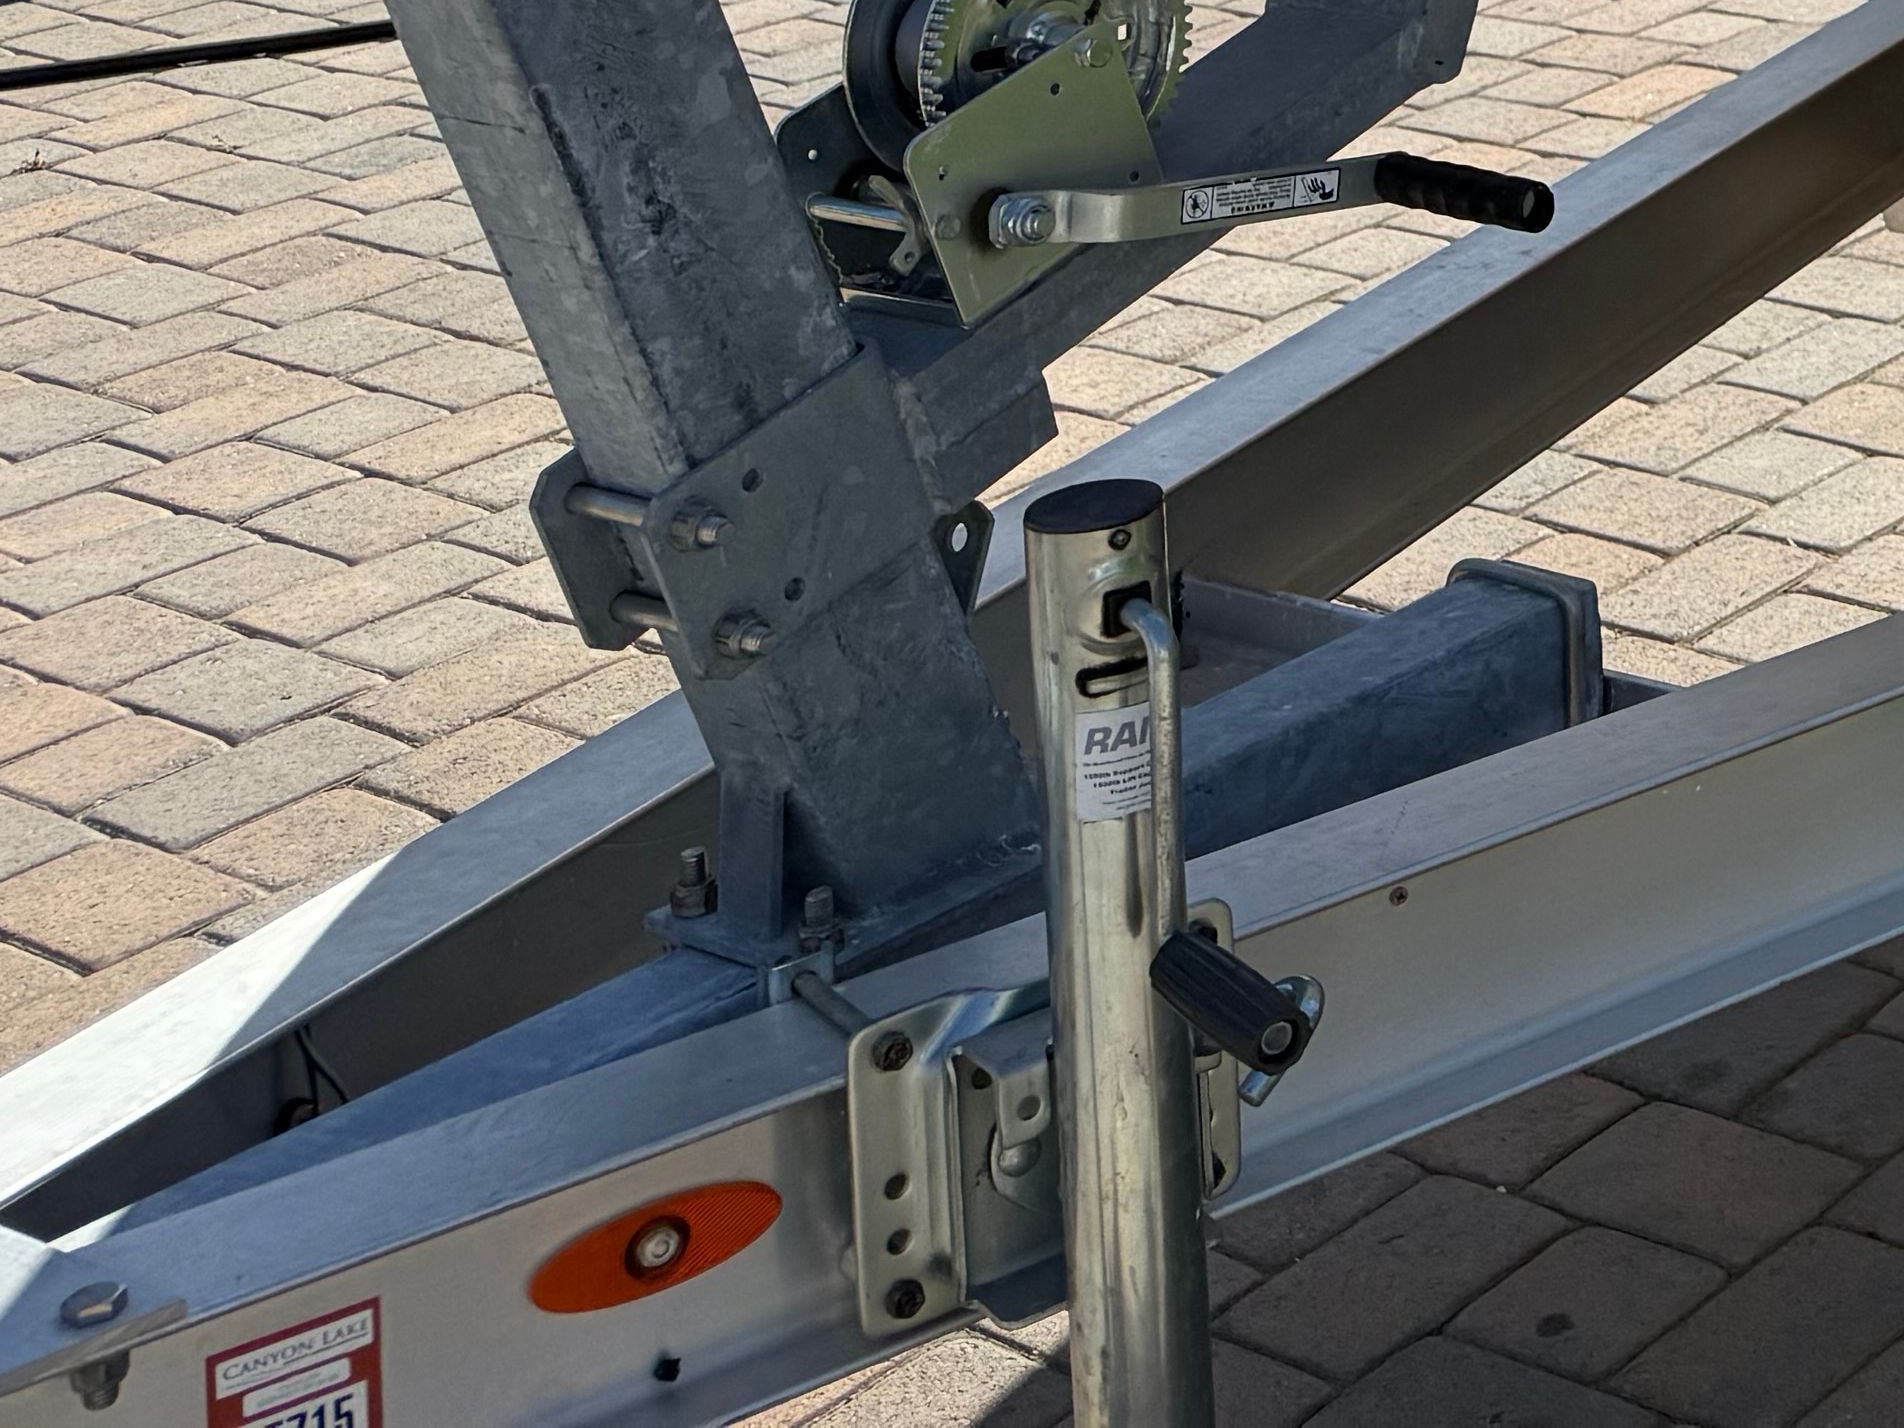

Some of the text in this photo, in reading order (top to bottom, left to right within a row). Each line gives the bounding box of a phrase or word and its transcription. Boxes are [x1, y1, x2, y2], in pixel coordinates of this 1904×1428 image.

[222, 1338, 313, 1381] CANYON
[322, 1317, 368, 1345] LAKE
[264, 1393, 354, 1428] 715
